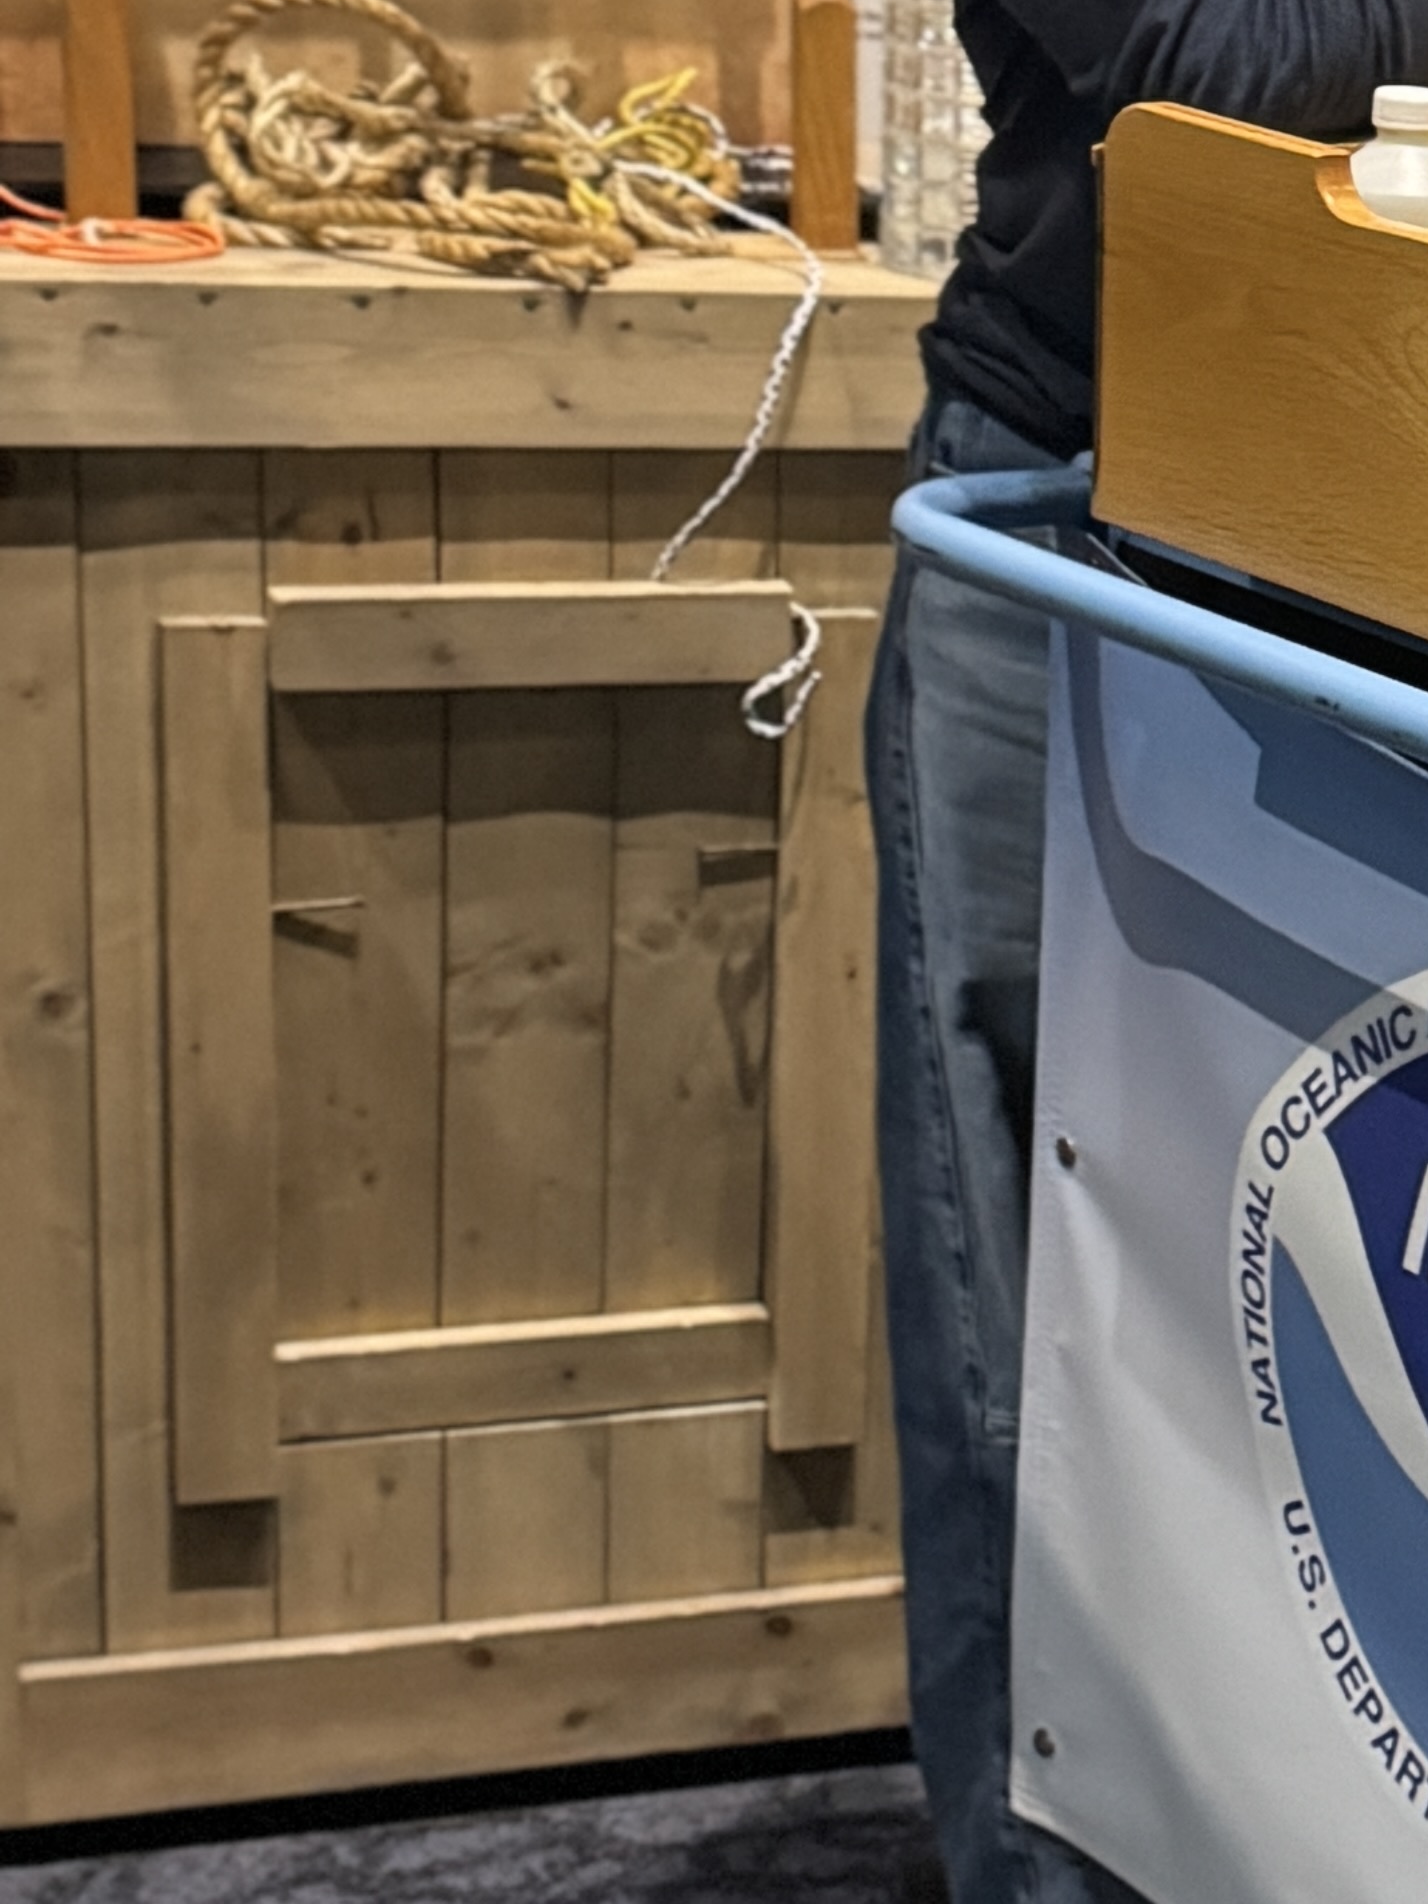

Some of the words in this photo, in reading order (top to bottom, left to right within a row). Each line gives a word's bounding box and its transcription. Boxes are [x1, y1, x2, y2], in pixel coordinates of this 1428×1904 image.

[1262, 1001, 1418, 1173] OCEANIC
[1247, 1184, 1281, 1426] NATIONAL
[1281, 1499, 1328, 1609] U.S.
